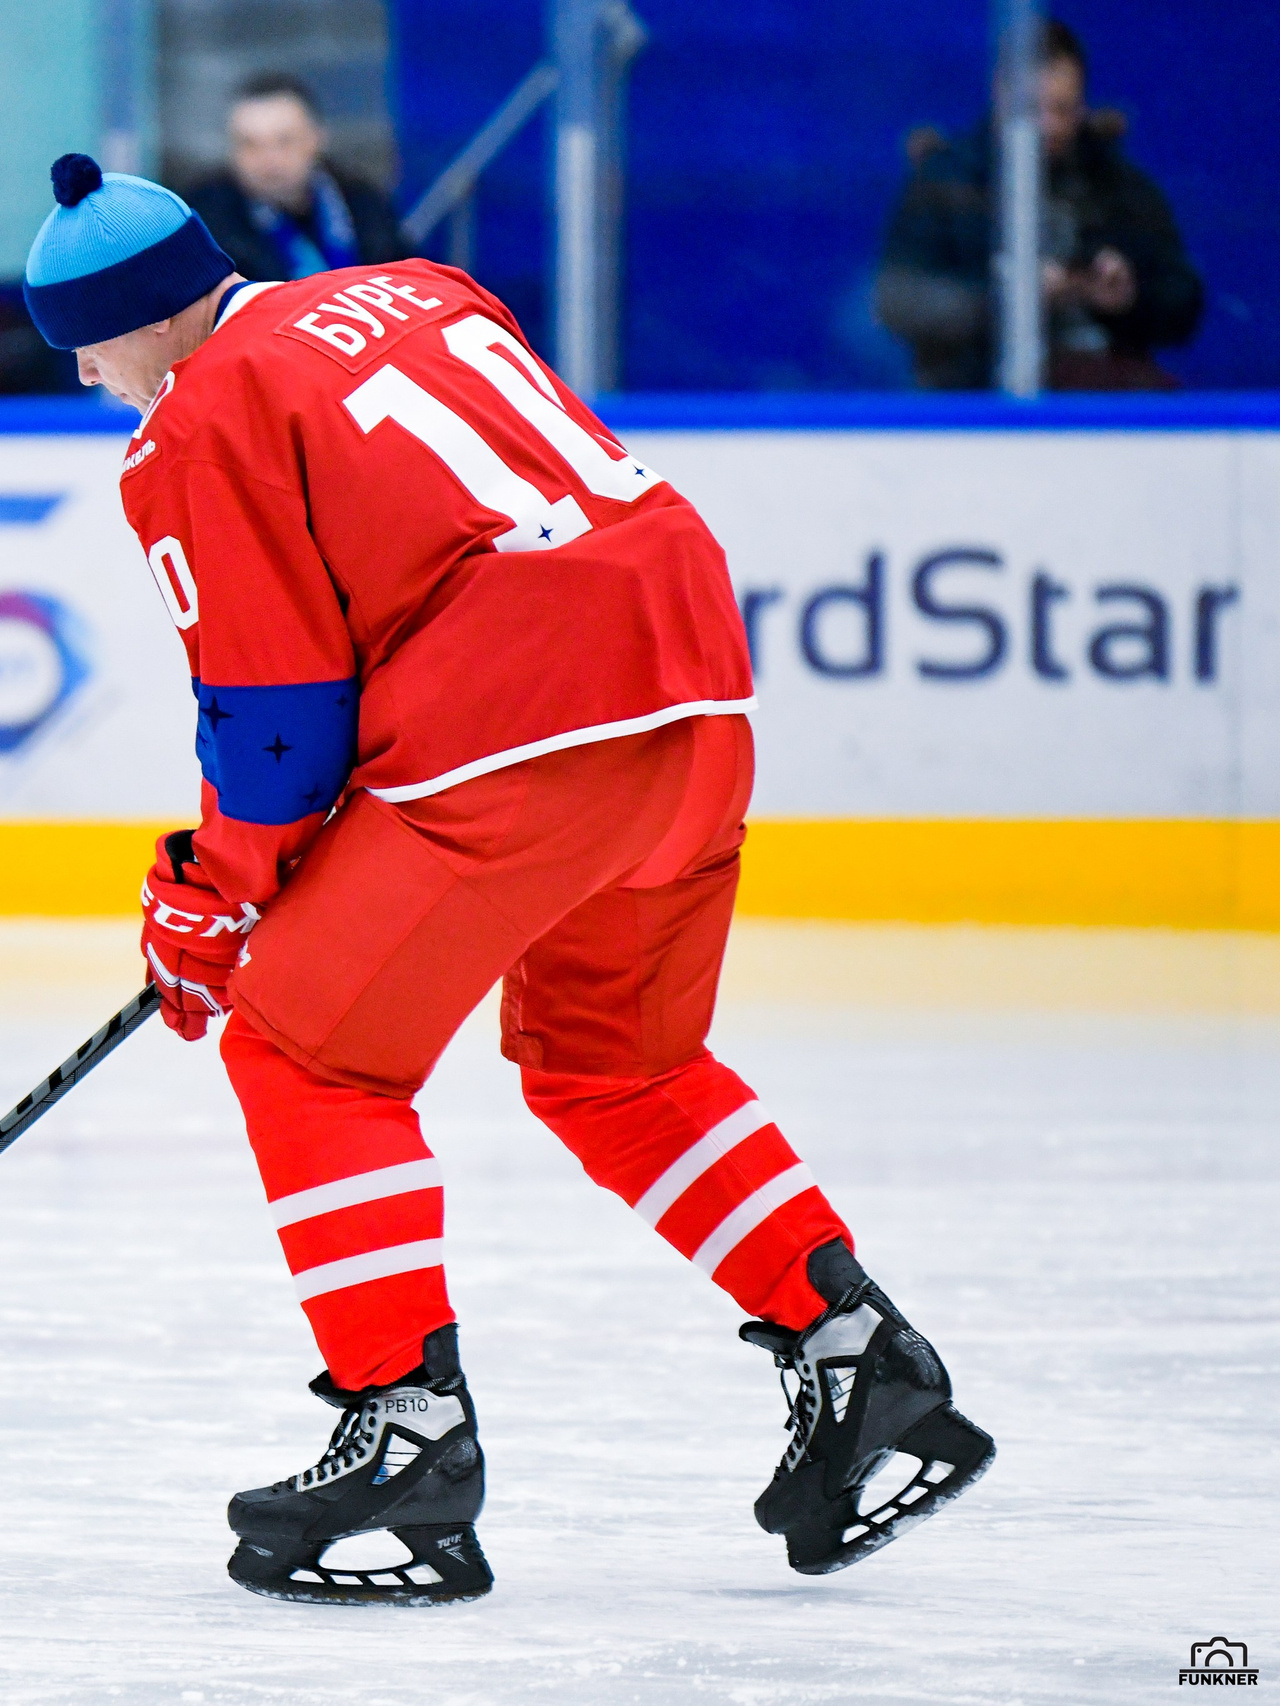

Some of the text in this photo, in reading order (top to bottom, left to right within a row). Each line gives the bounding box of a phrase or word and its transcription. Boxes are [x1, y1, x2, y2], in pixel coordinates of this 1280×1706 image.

[293, 276, 443, 357] БУРЕ
[343, 314, 666, 553] 10
[385, 1398, 429, 1413] PB10
